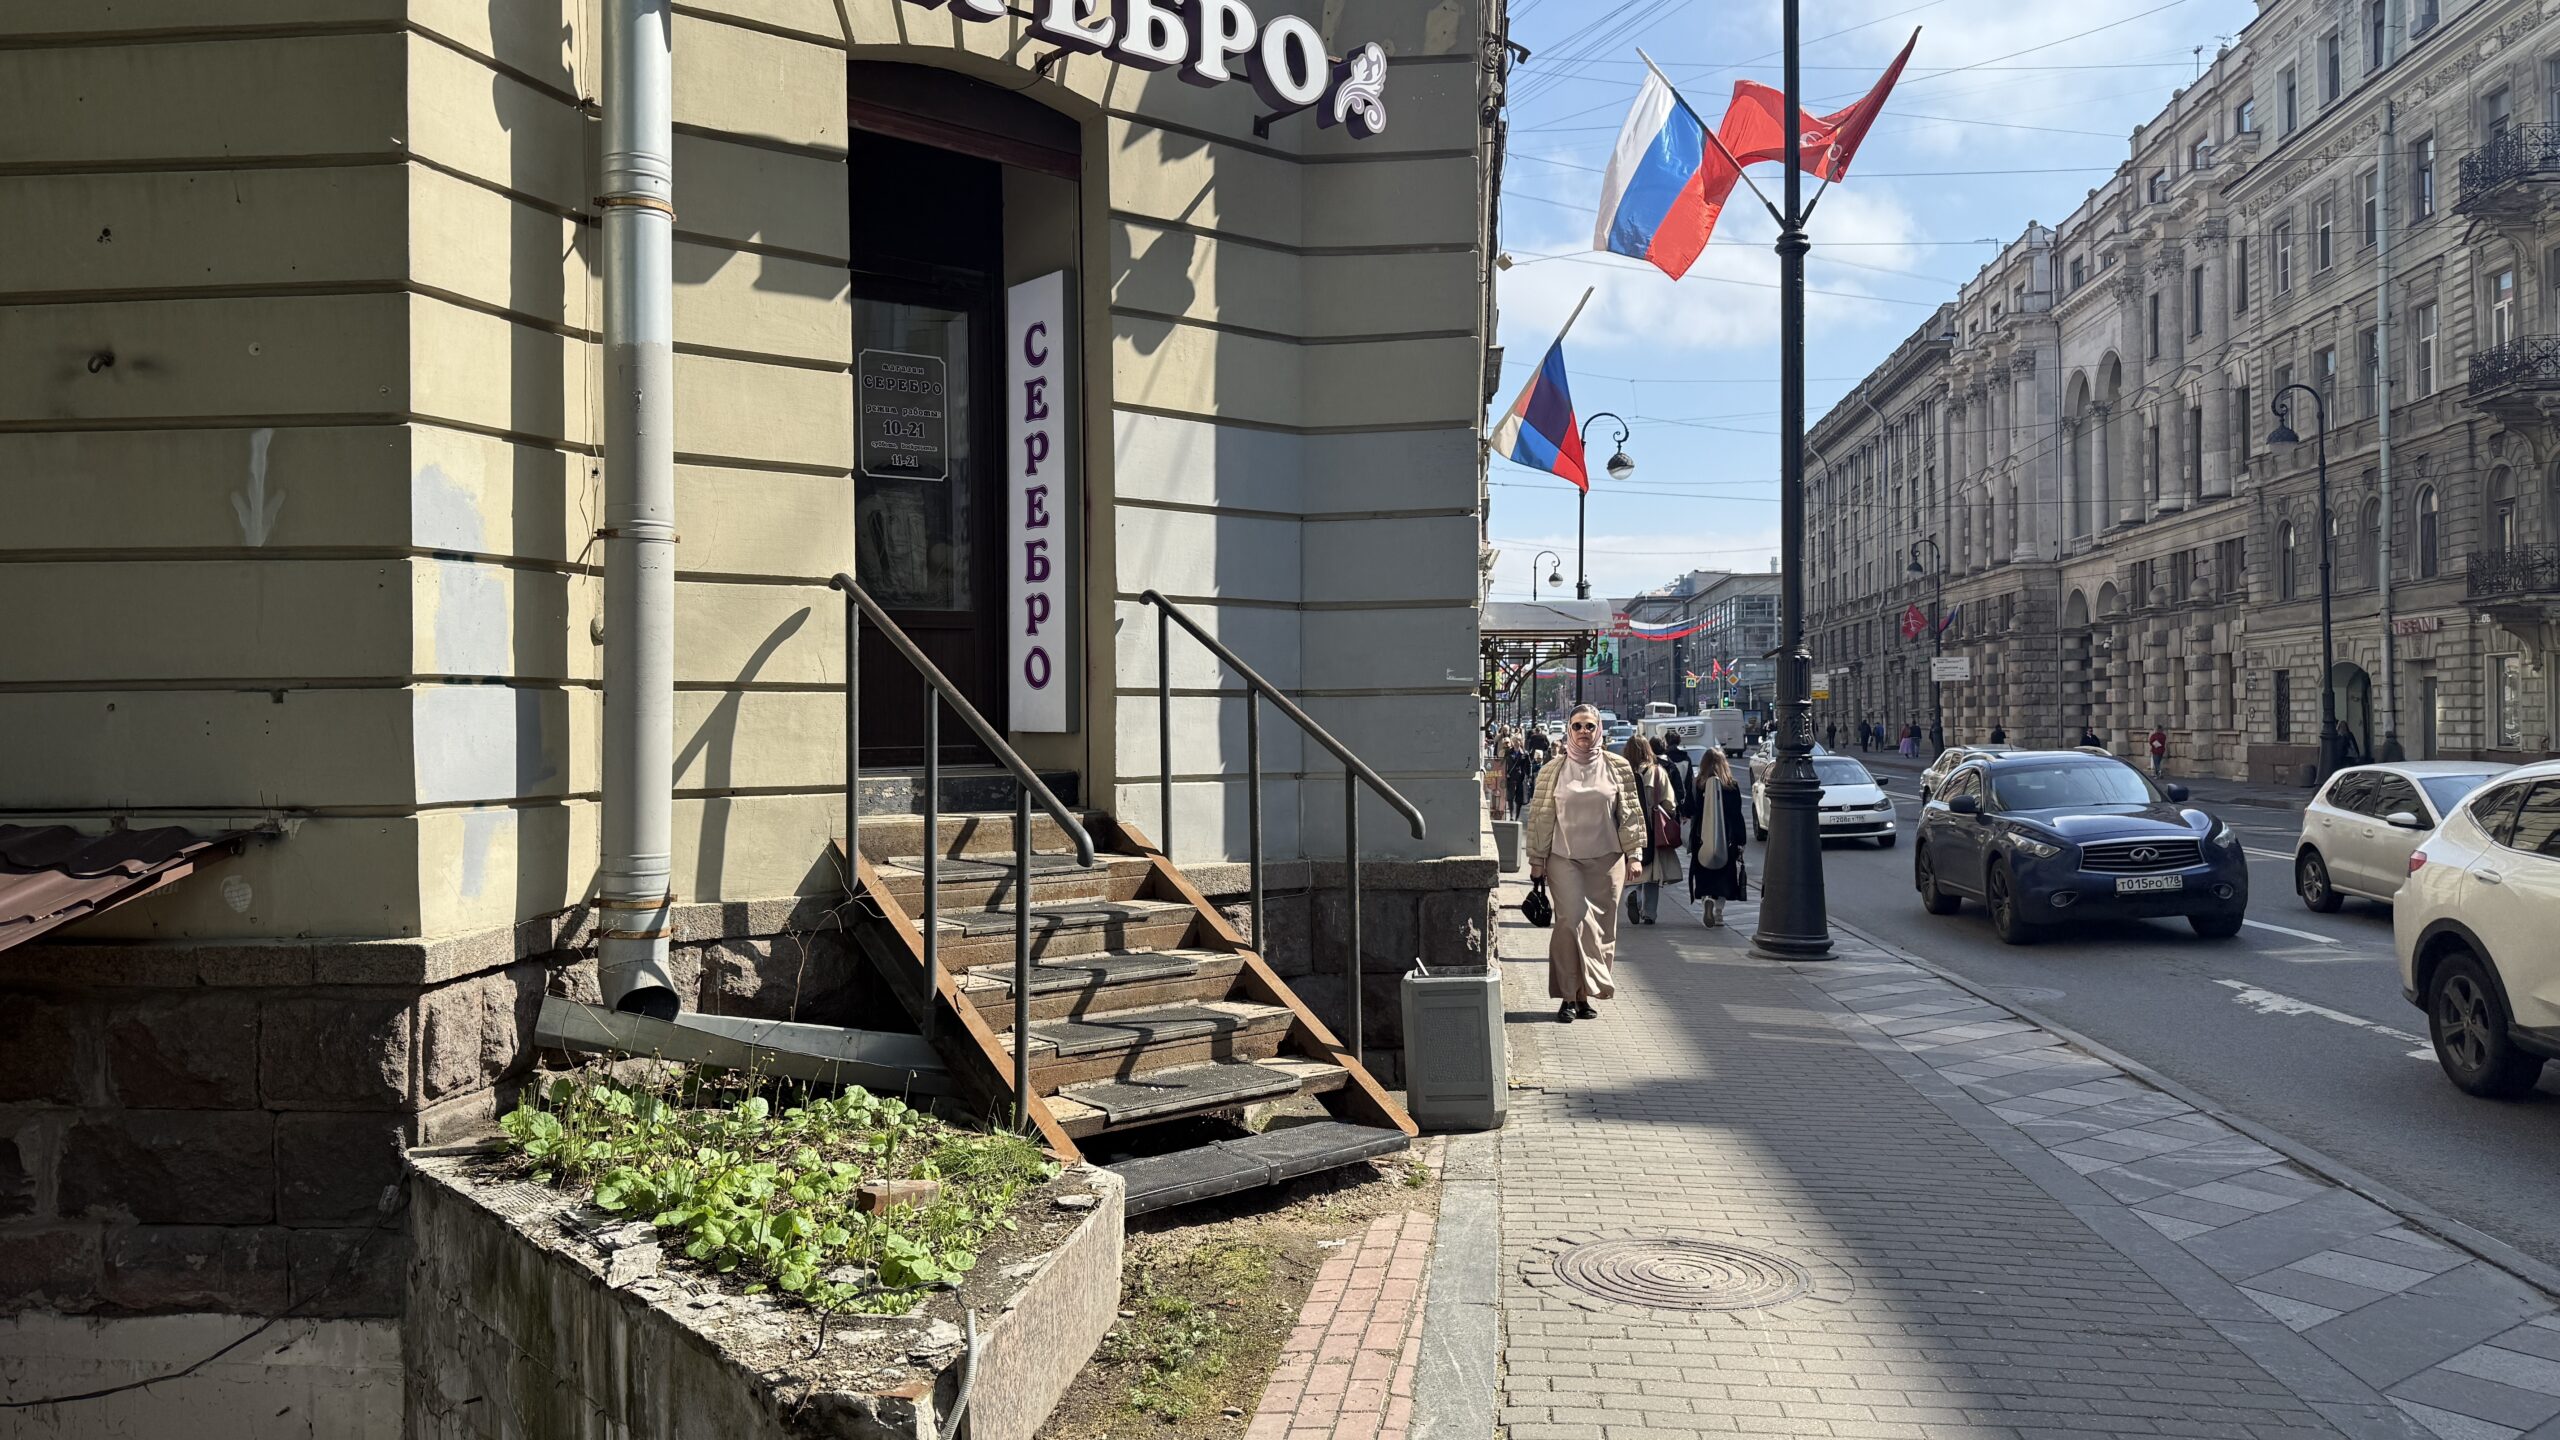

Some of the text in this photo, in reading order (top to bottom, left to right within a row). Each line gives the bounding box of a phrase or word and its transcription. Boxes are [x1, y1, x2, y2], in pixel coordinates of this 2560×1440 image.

[881, 363, 925, 375] магазин
[863, 375, 943, 395] СЕРЕБРО
[866, 404, 898, 415] режим
[883, 420, 925, 438] 10-21
[892, 454, 918, 467] 11-21
[1023, 320, 1053, 692] СЕРЕБРО
[2121, 878, 2162, 890] Т015РО
